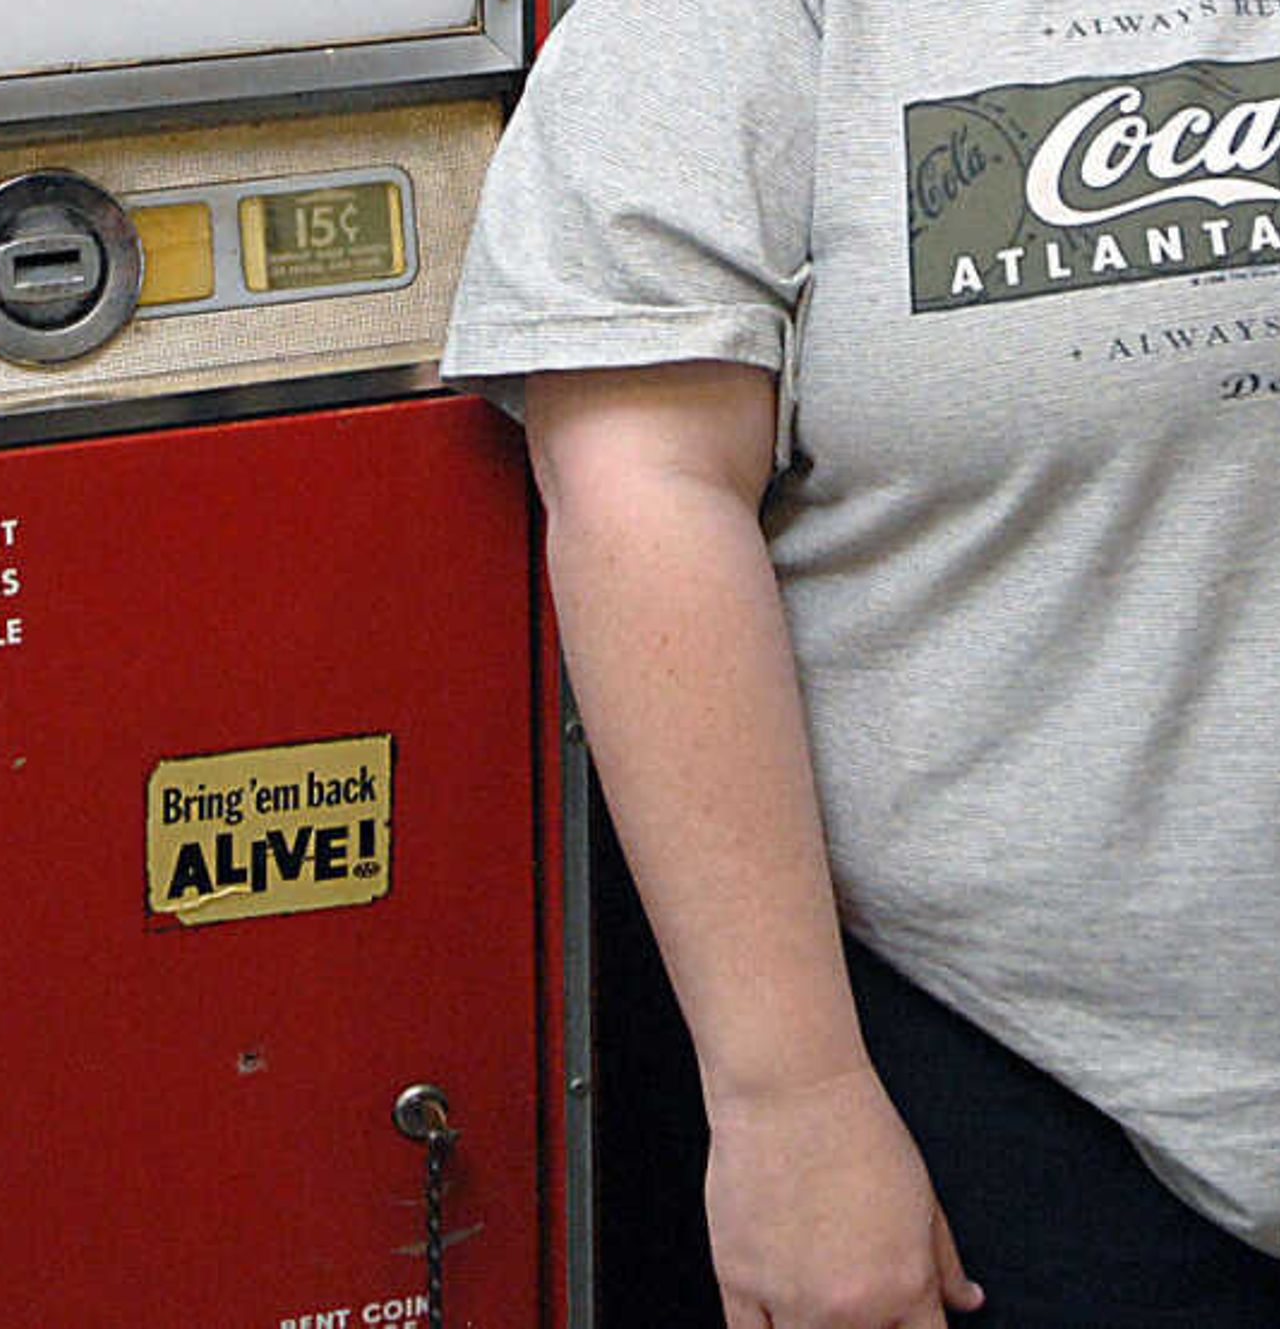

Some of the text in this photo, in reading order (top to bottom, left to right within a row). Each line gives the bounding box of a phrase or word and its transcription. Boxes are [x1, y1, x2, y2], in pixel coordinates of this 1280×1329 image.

[295, 202, 361, 249] 15¢
[162, 765, 377, 826] Bring 'em back
[167, 818, 376, 900] ALIVE!
